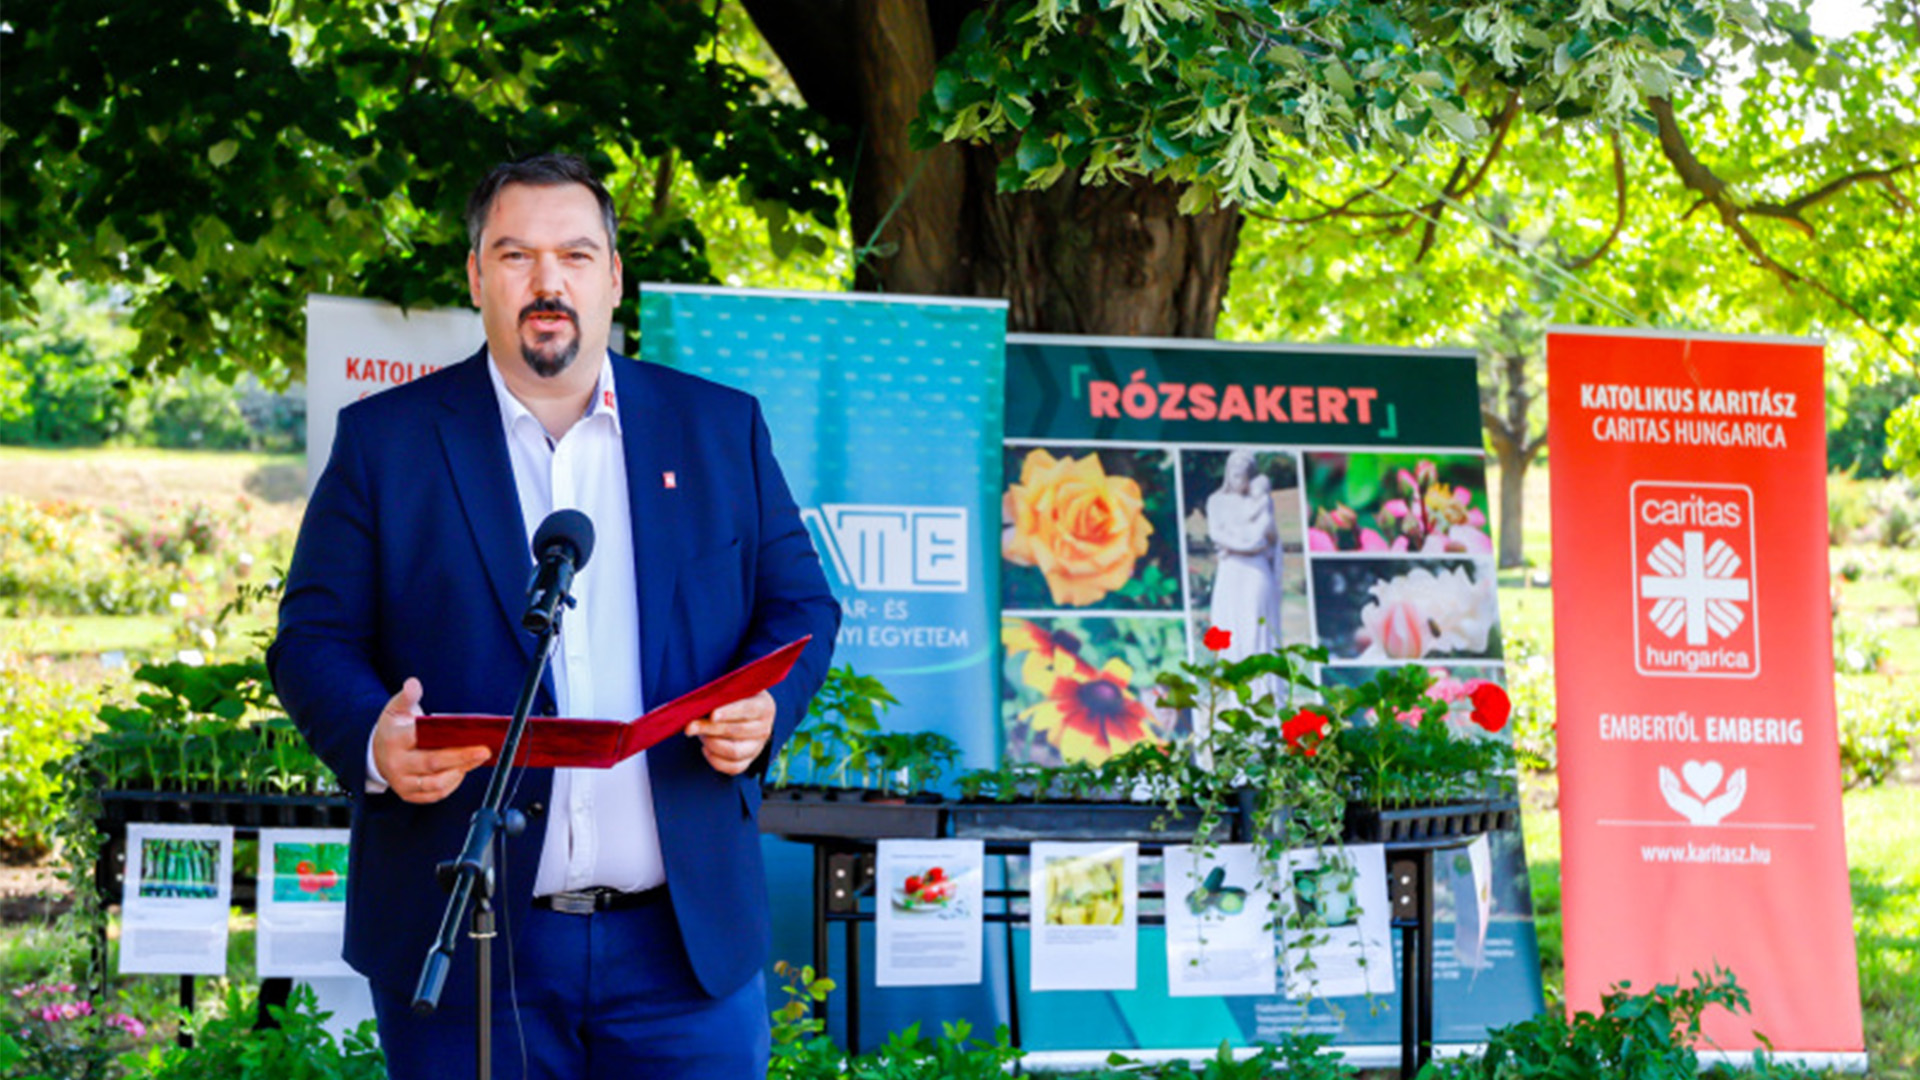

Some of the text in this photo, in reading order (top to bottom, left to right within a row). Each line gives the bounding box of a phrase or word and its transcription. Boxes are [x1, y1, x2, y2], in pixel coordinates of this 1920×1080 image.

[1088, 369, 1378, 424] RÓZSAKERT
[1580, 384, 1797, 418] KATOLIKUS KARITÁSZ
[1592, 416, 1787, 448] CARITAS HUNGARICA
[1641, 494, 1741, 528] caritas
[883, 597, 909, 620] ÉS
[867, 625, 969, 649] EGYETEM
[1646, 646, 1750, 673] hungarica
[1599, 712, 1803, 744] EMBERTŐL EMBERIG
[1641, 842, 1771, 865] www.karitasz.hu
